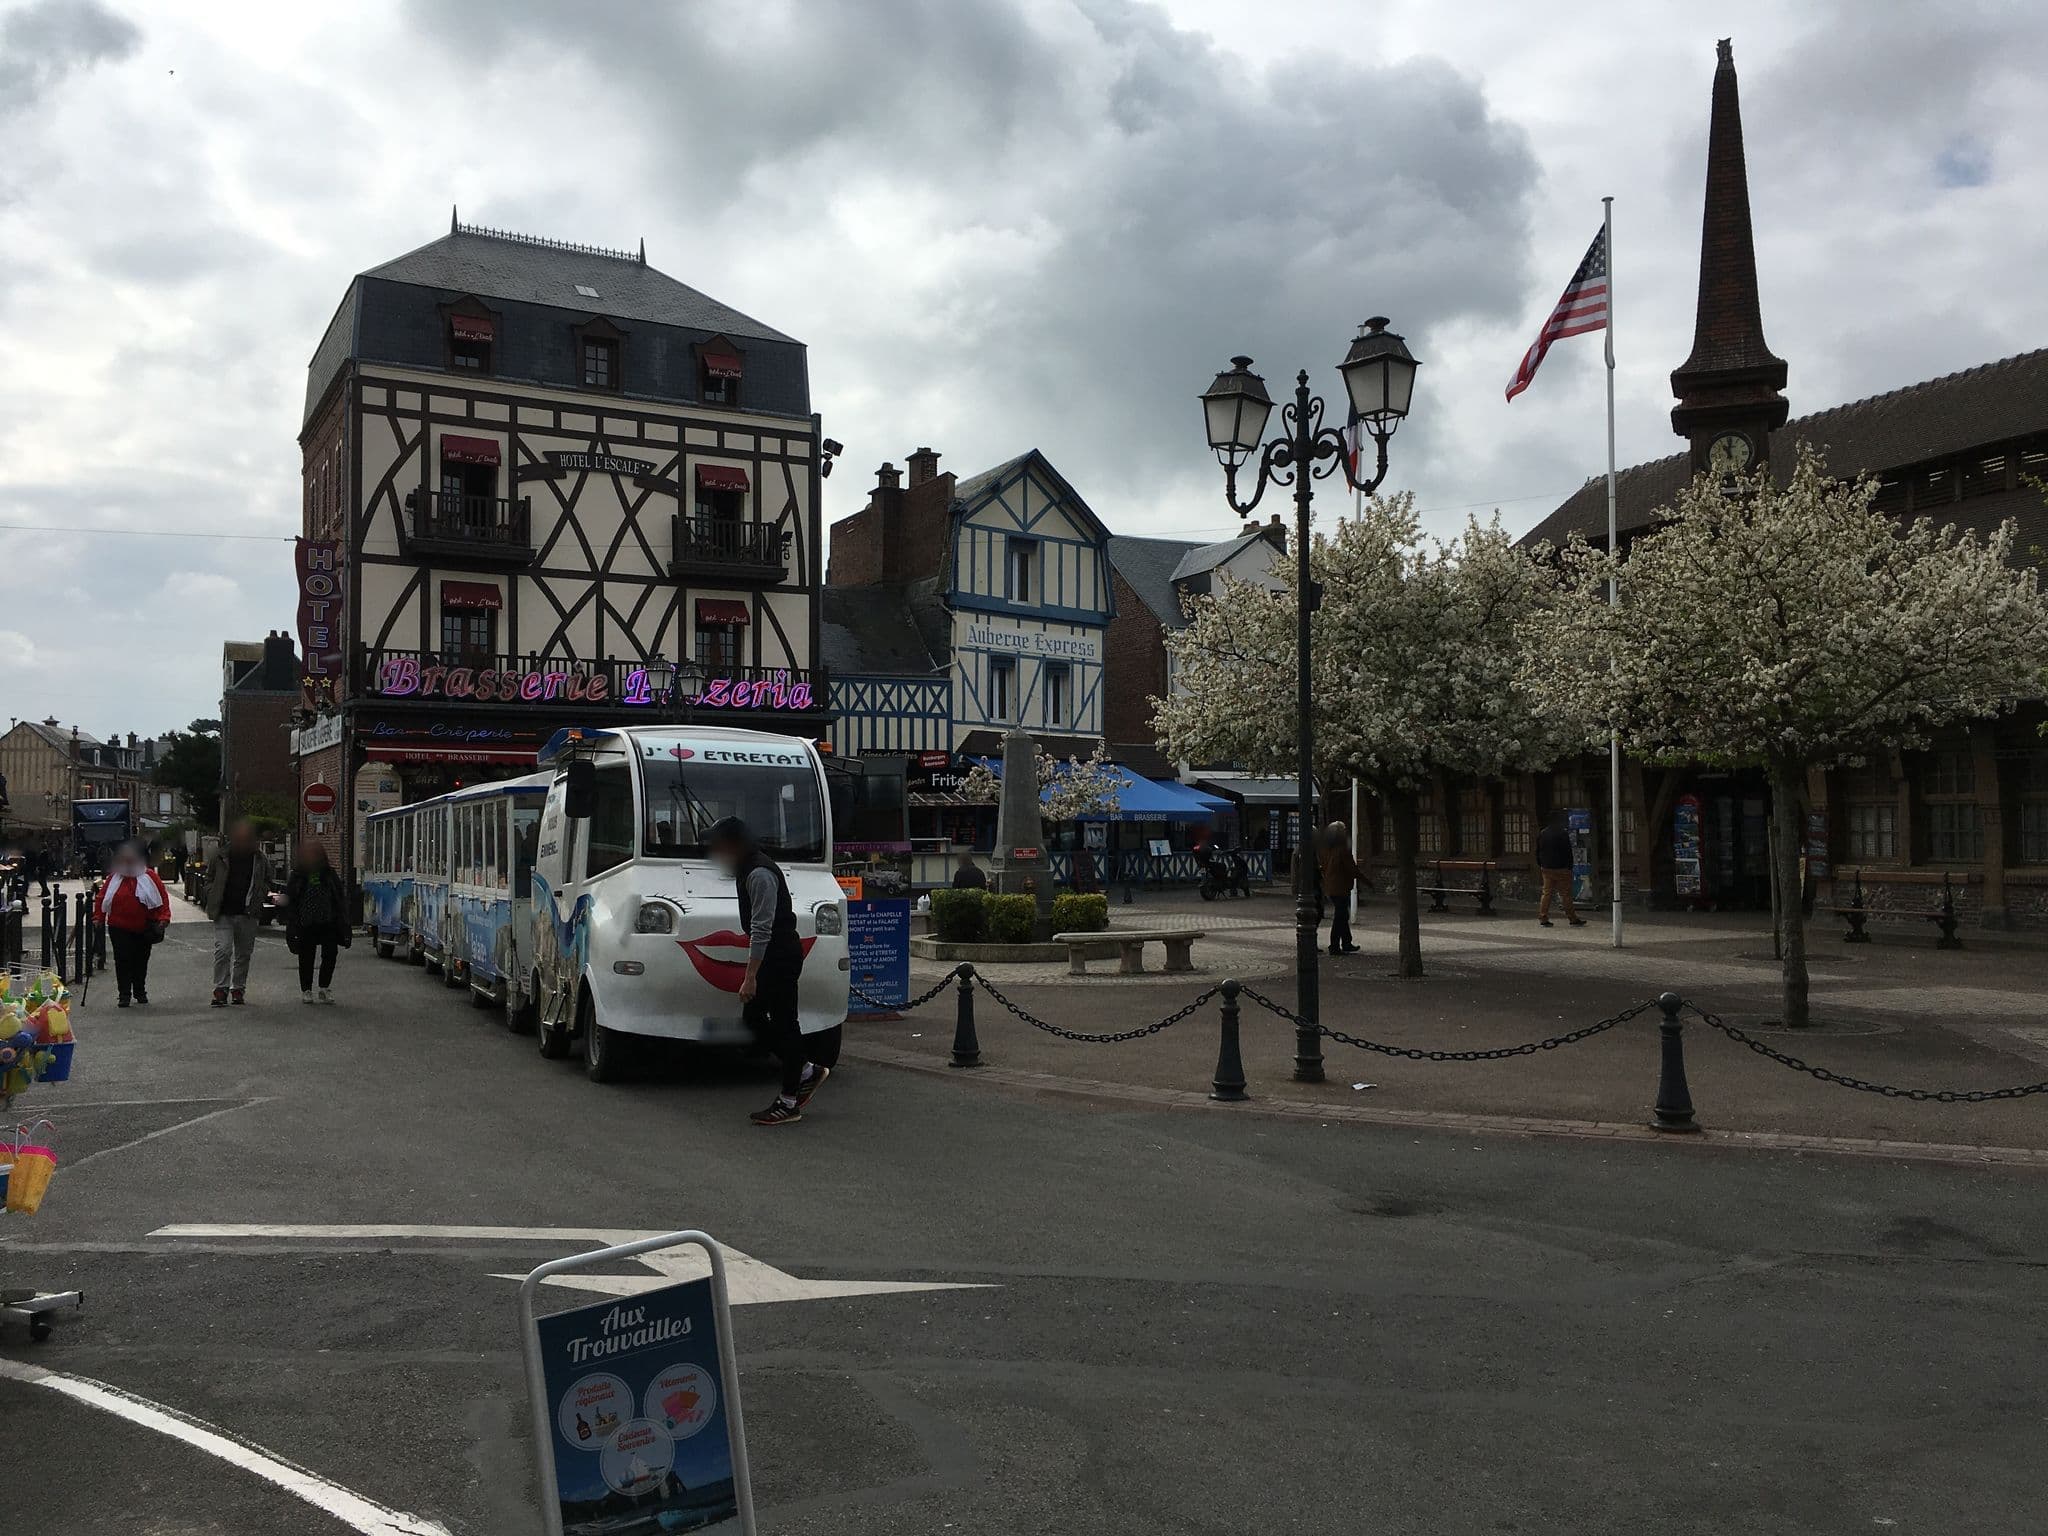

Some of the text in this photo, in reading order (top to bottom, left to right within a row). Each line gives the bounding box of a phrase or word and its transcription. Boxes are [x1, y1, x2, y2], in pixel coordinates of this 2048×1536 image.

[559, 453, 640, 474] HOTEL L'ESCALE
[306, 548, 333, 674] HOTEL
[967, 624, 1095, 658] Auberge Express
[380, 656, 609, 701] Brasserie
[372, 721, 407, 737] Bar
[405, 752, 490, 761] HOTEL BRASSERIE
[704, 750, 805, 765] ETRETAT
[1109, 813, 1123, 821] BAR
[600, 1304, 646, 1336] Aux
[566, 1315, 692, 1364] Trouvailles
